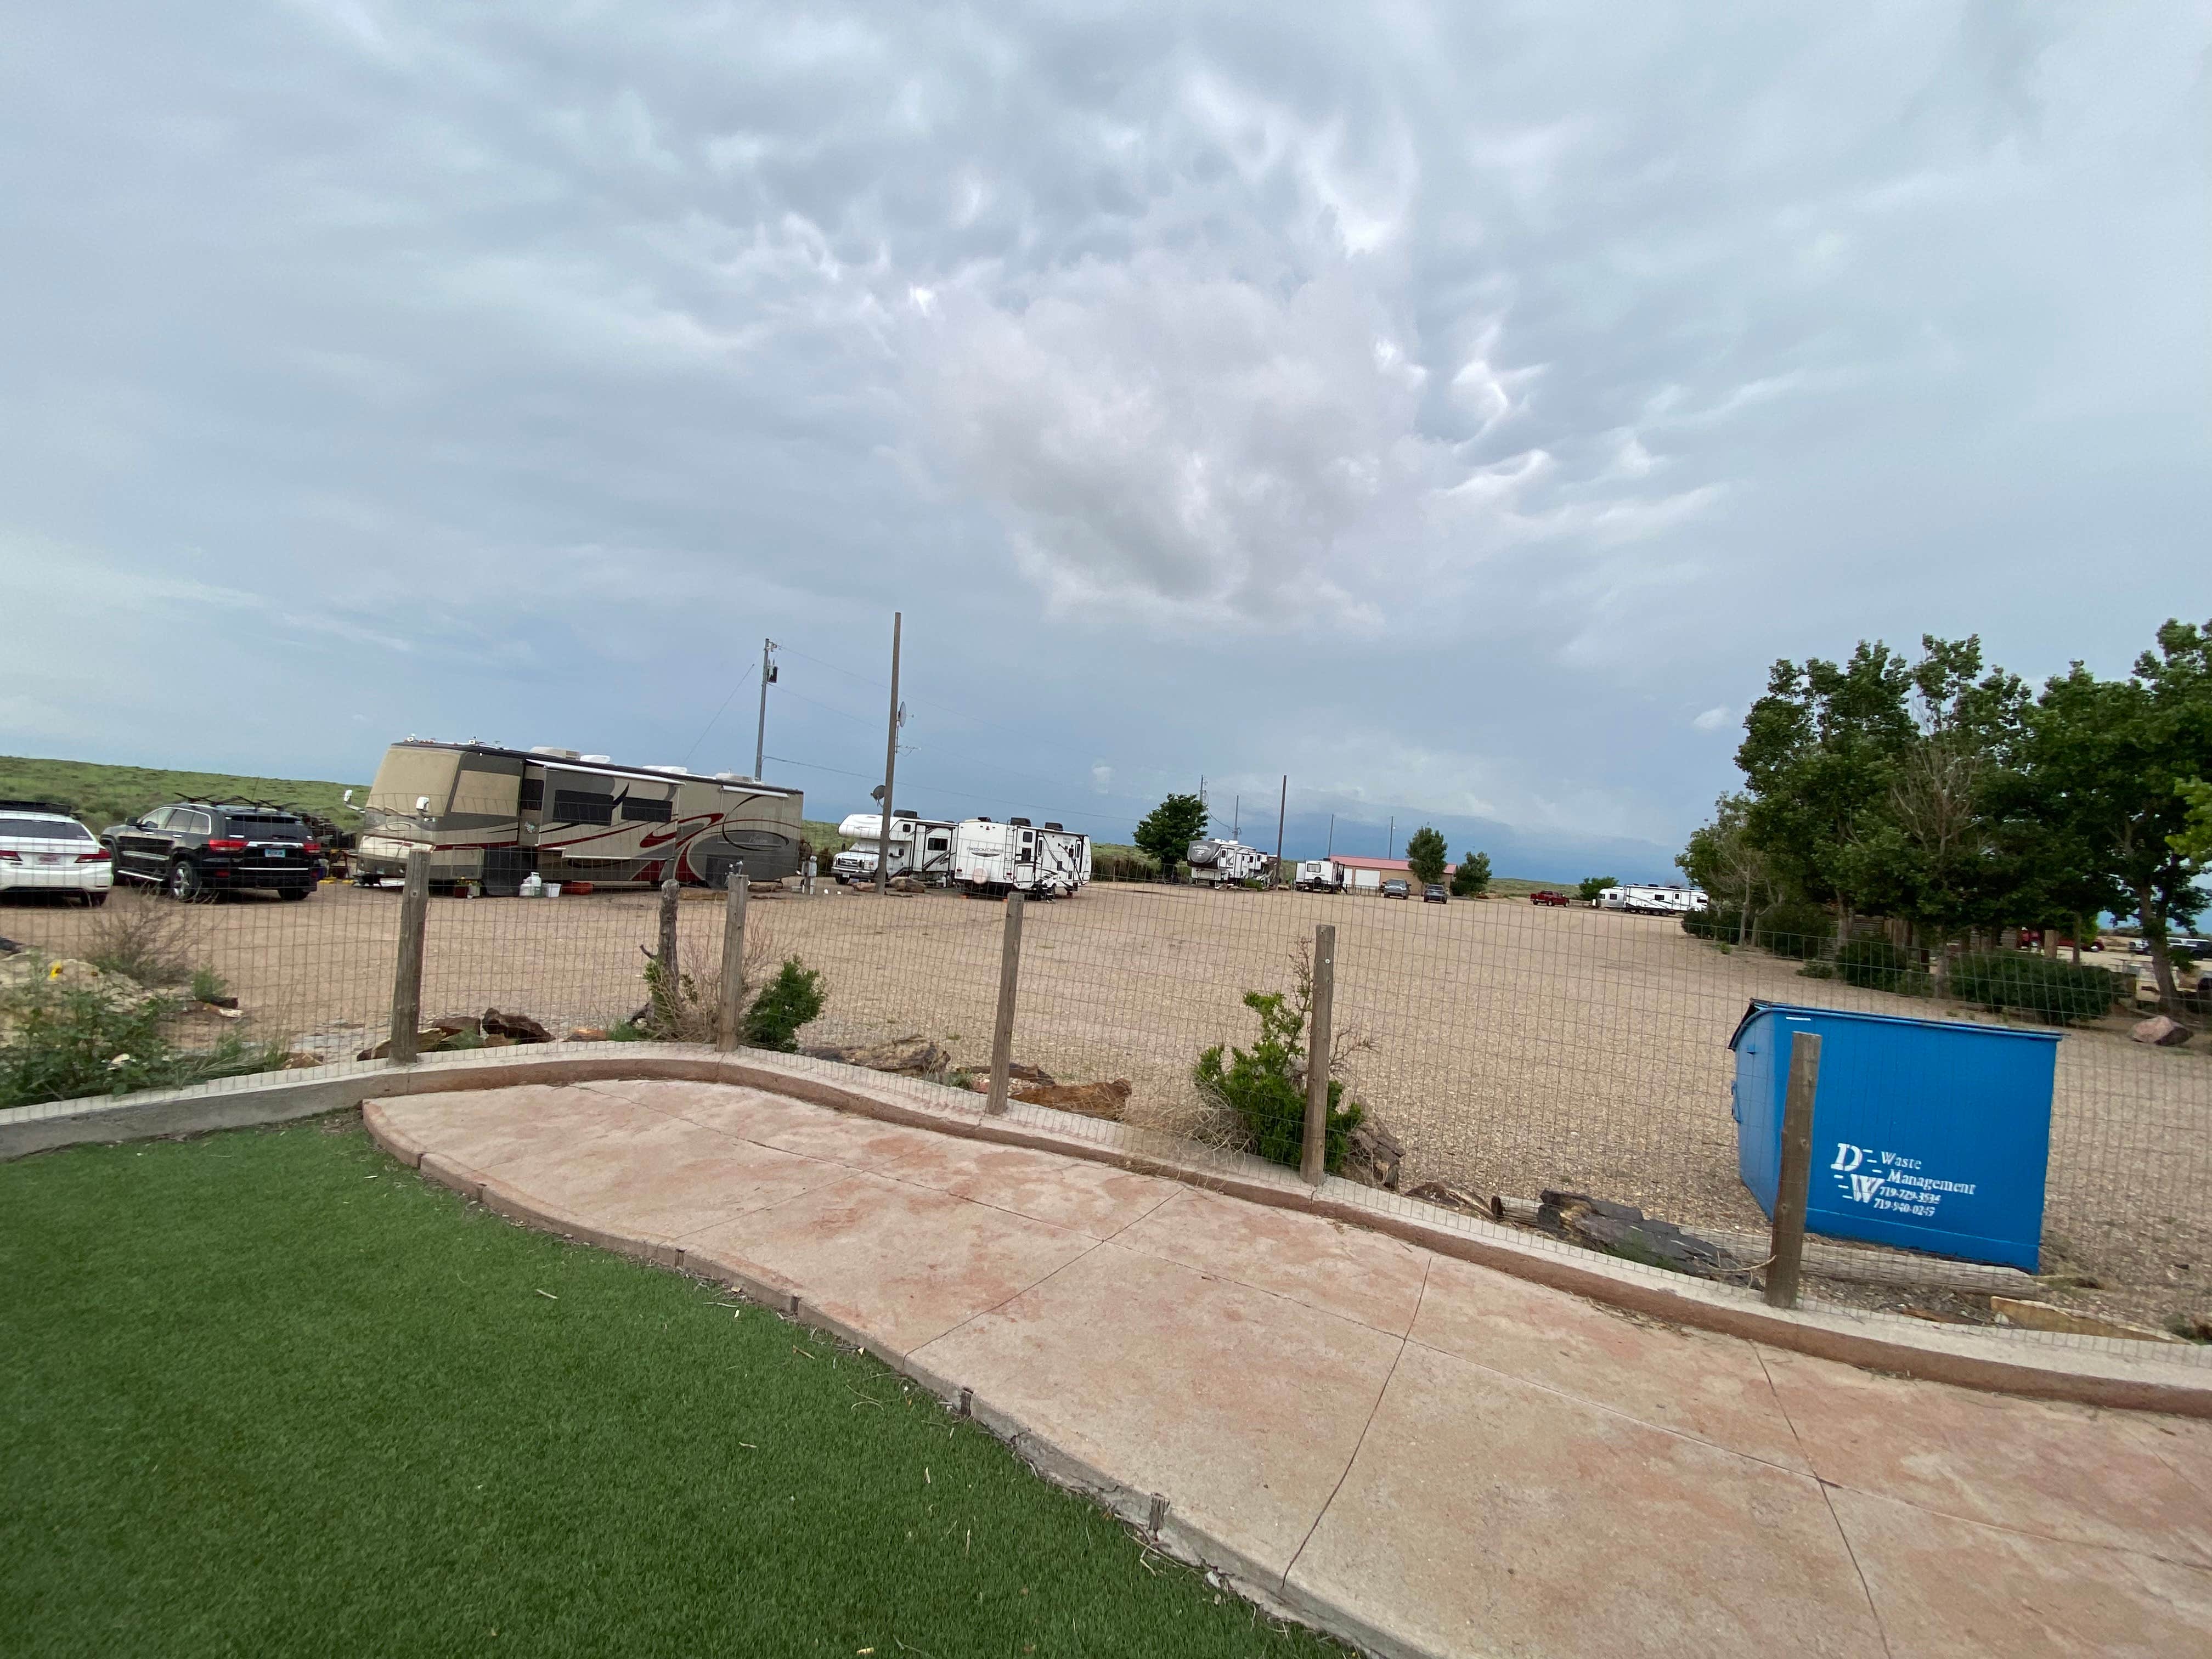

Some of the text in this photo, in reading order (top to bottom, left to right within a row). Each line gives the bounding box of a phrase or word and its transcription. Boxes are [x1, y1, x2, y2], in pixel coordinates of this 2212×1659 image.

[1831, 1142, 1863, 1171] D
[1881, 1151, 1922, 1170] Waste
[1850, 1173, 1885, 1203] W
[1887, 1169, 1976, 1194] Management
